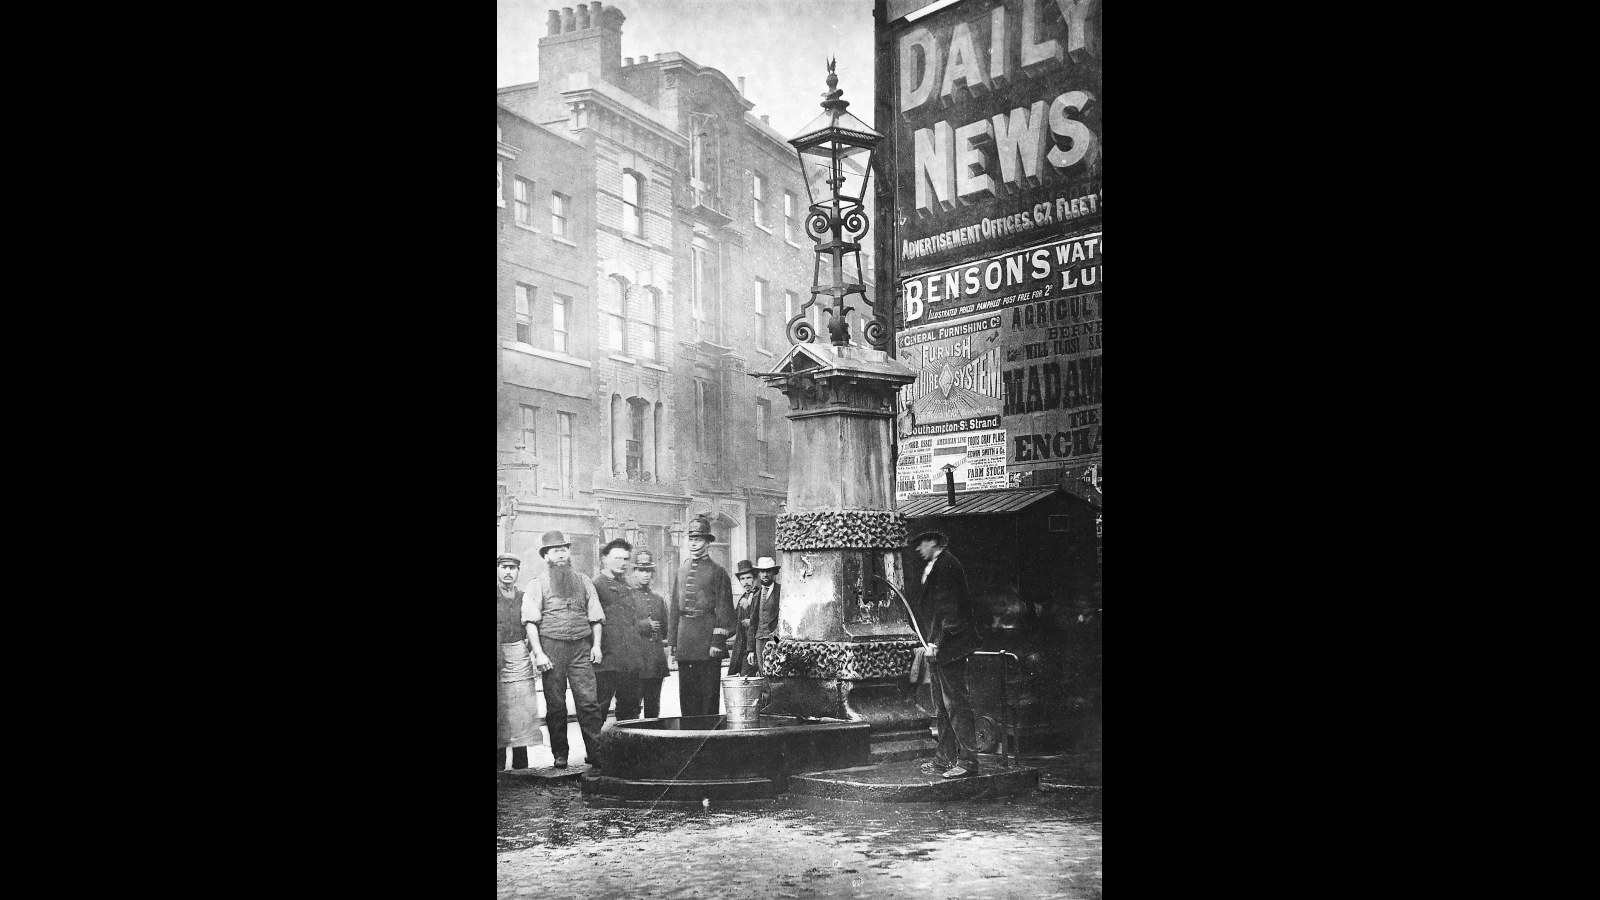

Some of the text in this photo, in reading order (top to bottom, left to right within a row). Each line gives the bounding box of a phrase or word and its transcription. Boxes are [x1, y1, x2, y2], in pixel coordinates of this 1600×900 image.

[900, 0, 1091, 114] DAILY
[915, 91, 1091, 211] NEWS
[902, 224, 980, 261] ADVERTISEMENT
[1056, 194, 1098, 221] FLEET
[905, 238, 1102, 322] BENSON'S WAT
[1061, 265, 1102, 291] LU
[927, 307, 958, 321] ILLUSTRATED
[959, 304, 975, 315] PRICED
[976, 298, 1001, 311] PAMPHLET
[1003, 294, 1017, 305] POST
[1017, 291, 1030, 302] FREE
[1031, 289, 1042, 299] FOR
[904, 331, 936, 347] GENERAL
[939, 320, 987, 339] FURNISHING
[922, 335, 972, 369] FURNISH
[919, 369, 939, 399] HIRE
[953, 346, 1001, 400] SYSTEM
[1068, 408, 1099, 429] THE
[967, 467, 984, 479] FARM
[985, 465, 1005, 477] STOCK
